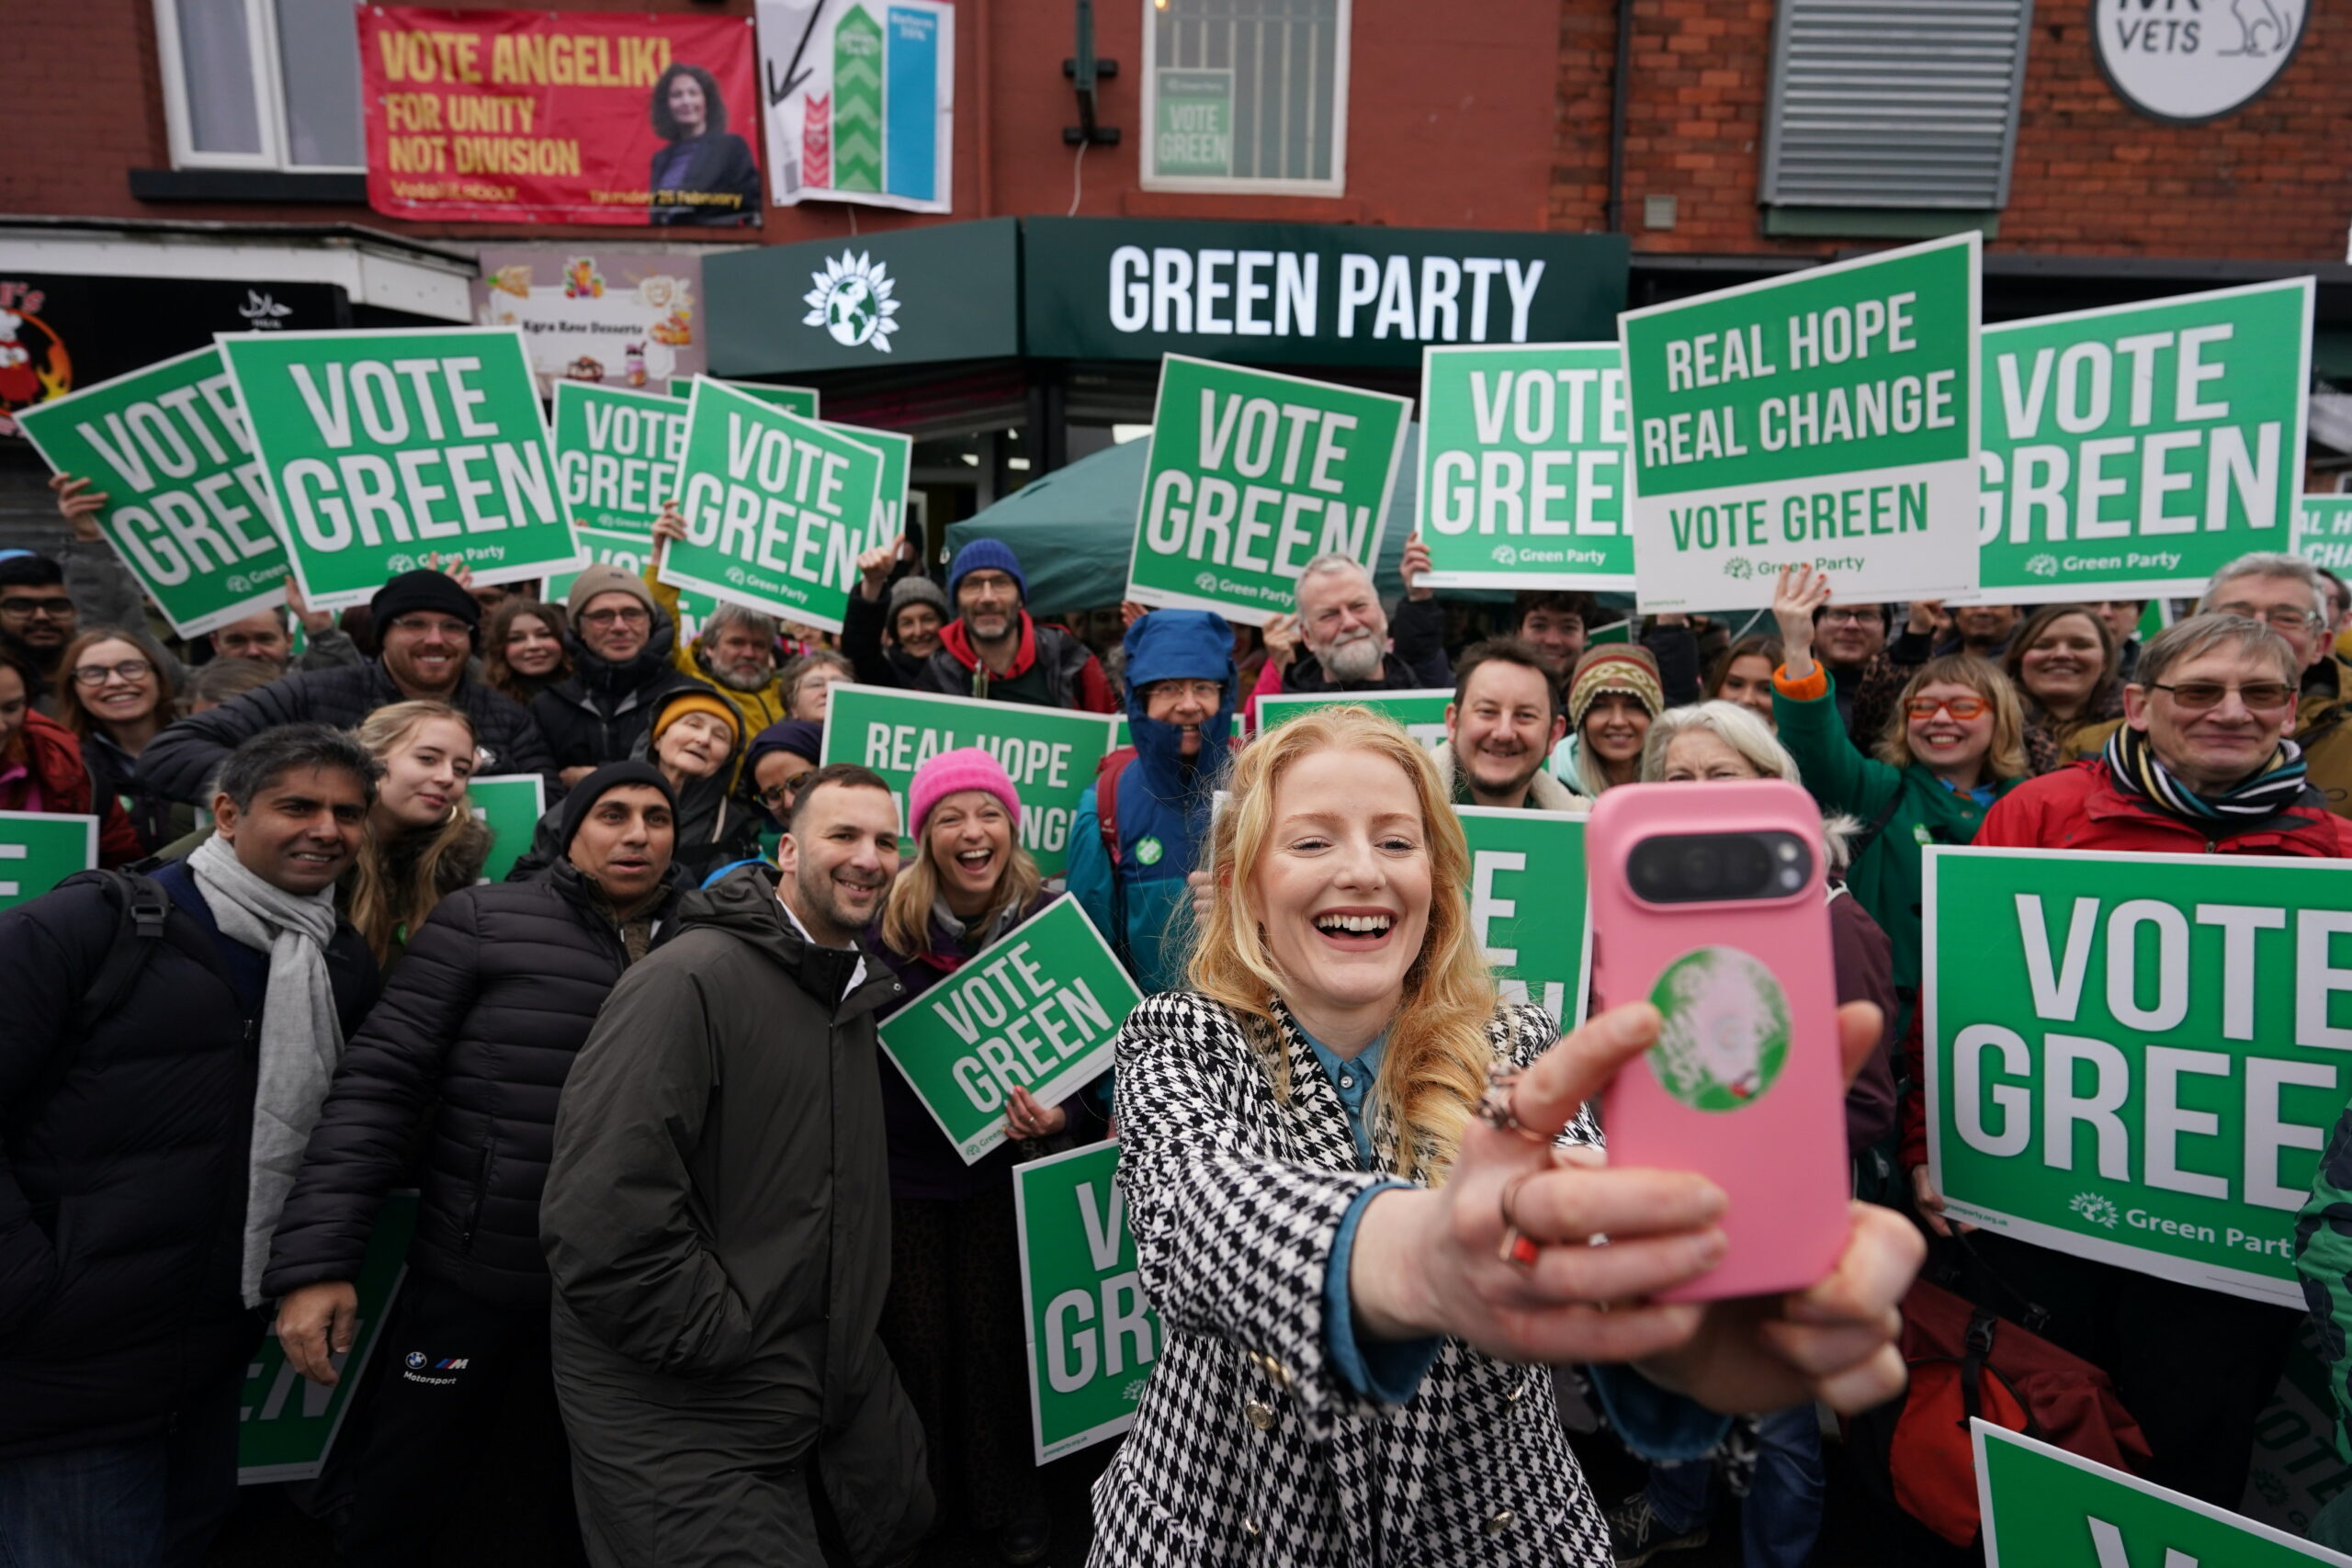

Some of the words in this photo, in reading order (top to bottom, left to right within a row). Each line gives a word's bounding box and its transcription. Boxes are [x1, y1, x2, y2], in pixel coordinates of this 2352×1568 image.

[379, 31, 481, 85] VOTE
[2117, 18, 2201, 54] VETS
[386, 93, 443, 132] FOR
[448, 96, 536, 134] UNITY
[1159, 131, 1228, 163] GREEN
[1169, 104, 1219, 130] VOTE
[388, 136, 447, 173] NOT
[454, 137, 581, 176] DIVISION
[677, 189, 742, 209] February
[1108, 244, 1319, 337] GREEN
[1338, 253, 1546, 343] PARTY
[1666, 322, 1775, 393] REAL
[1788, 291, 1917, 371] HOPE
[288, 355, 501, 449] VOTE
[1470, 369, 1629, 446] VOTE
[1643, 404, 1747, 468] REAL
[1758, 368, 1957, 452] CHANGE
[1997, 321, 2235, 441] VOTE
[75, 374, 253, 493] VOTE
[583, 400, 685, 461] VOTE
[728, 411, 851, 517] VOTE
[1198, 387, 1359, 494] VOTE
[282, 439, 560, 553] GREEN
[560, 450, 678, 516] GREE
[1430, 449, 1634, 536] GREE
[1668, 499, 1768, 552] VOTE
[1781, 481, 1928, 539] GREEN
[110, 461, 280, 586] GRE
[417, 547, 468, 569] Geen
[469, 544, 505, 563] Party
[680, 472, 864, 594] GREEN
[1145, 468, 1372, 580] GREEN
[1520, 547, 1564, 562] Green
[1566, 548, 1607, 567] Party
[2062, 555, 2121, 571] Green
[2126, 550, 2182, 570] Party
[249, 562, 289, 584] Green
[746, 573, 780, 594] Green
[780, 583, 809, 605] Party
[1219, 578, 1258, 597] Green
[1260, 586, 1295, 607] Party
[1815, 557, 1865, 572] Party
[931, 941, 1057, 1046] VOTE
[2014, 893, 2352, 1052] VOTE
[951, 976, 1114, 1114] GREEN
[1952, 1022, 2337, 1213] GREE
[2125, 1208, 2216, 1244] Green
[2225, 1227, 2297, 1267] Part
[403, 1371, 458, 1386] Motorsport
[2255, 1395, 2352, 1508] OTE
